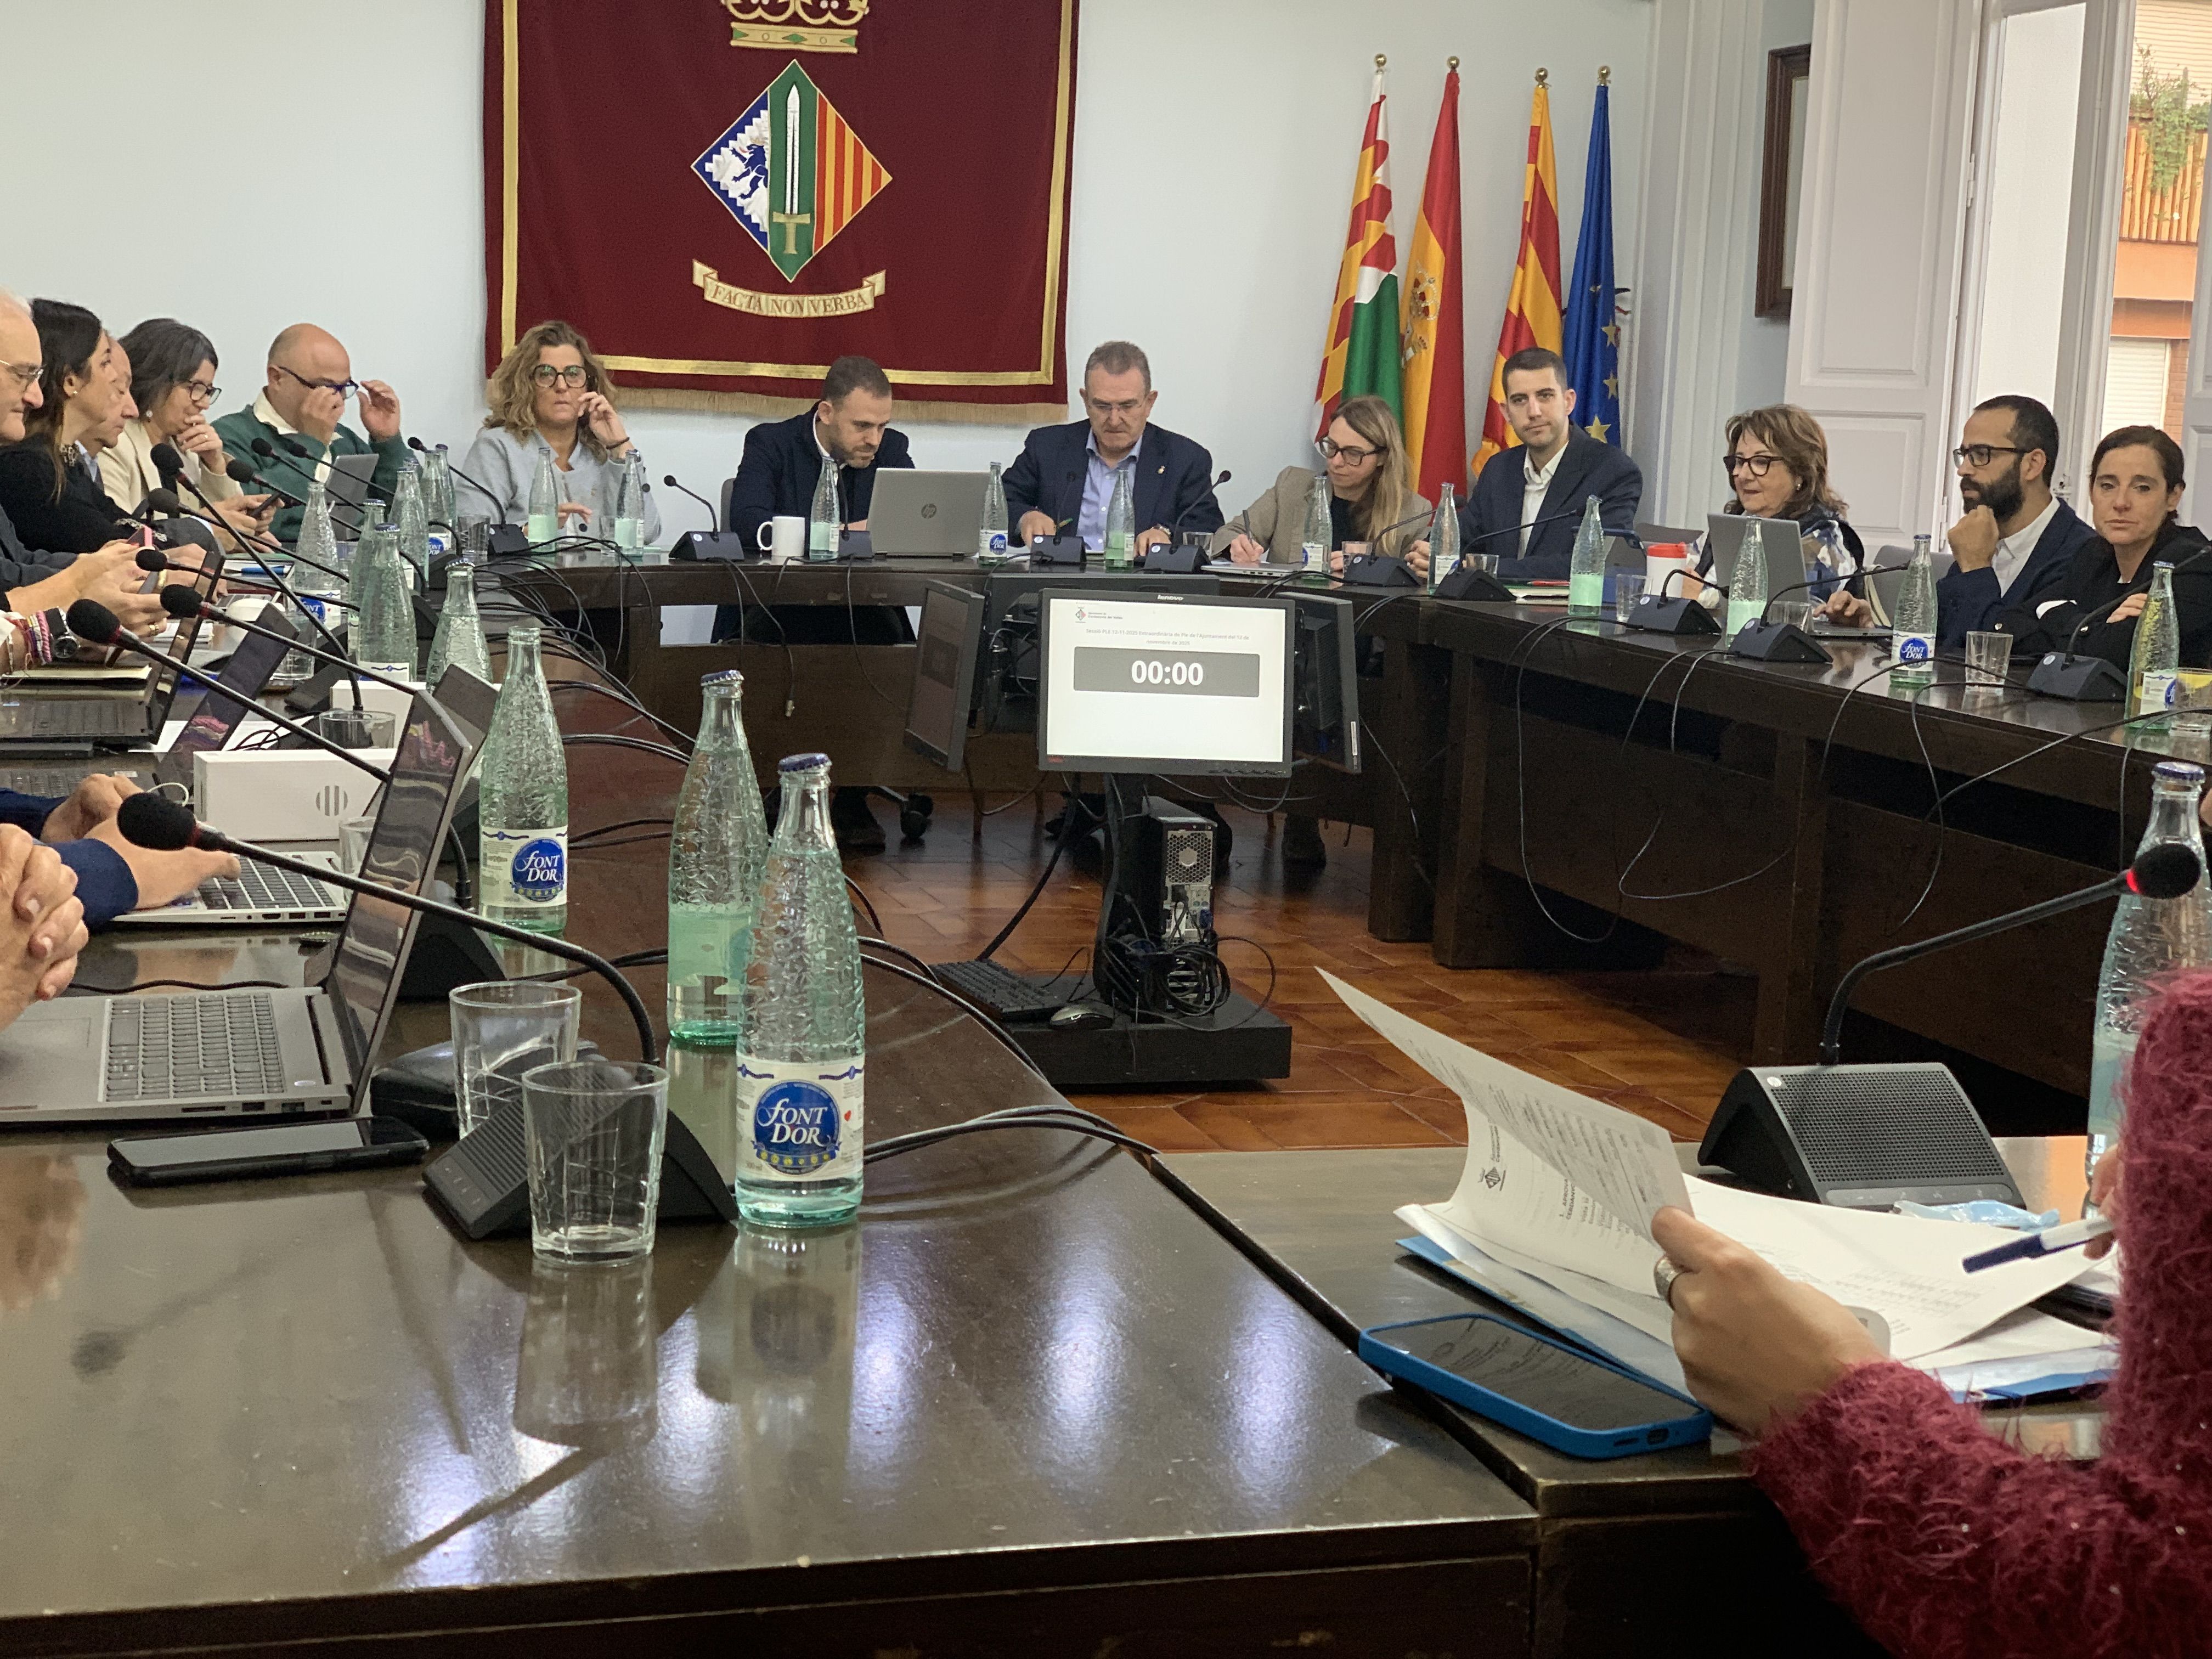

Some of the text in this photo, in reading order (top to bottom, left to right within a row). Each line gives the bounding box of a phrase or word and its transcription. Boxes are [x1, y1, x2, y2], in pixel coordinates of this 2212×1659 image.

[711, 285, 868, 314] FACTA NON VERBA
[1131, 660, 1204, 686] 00:00
